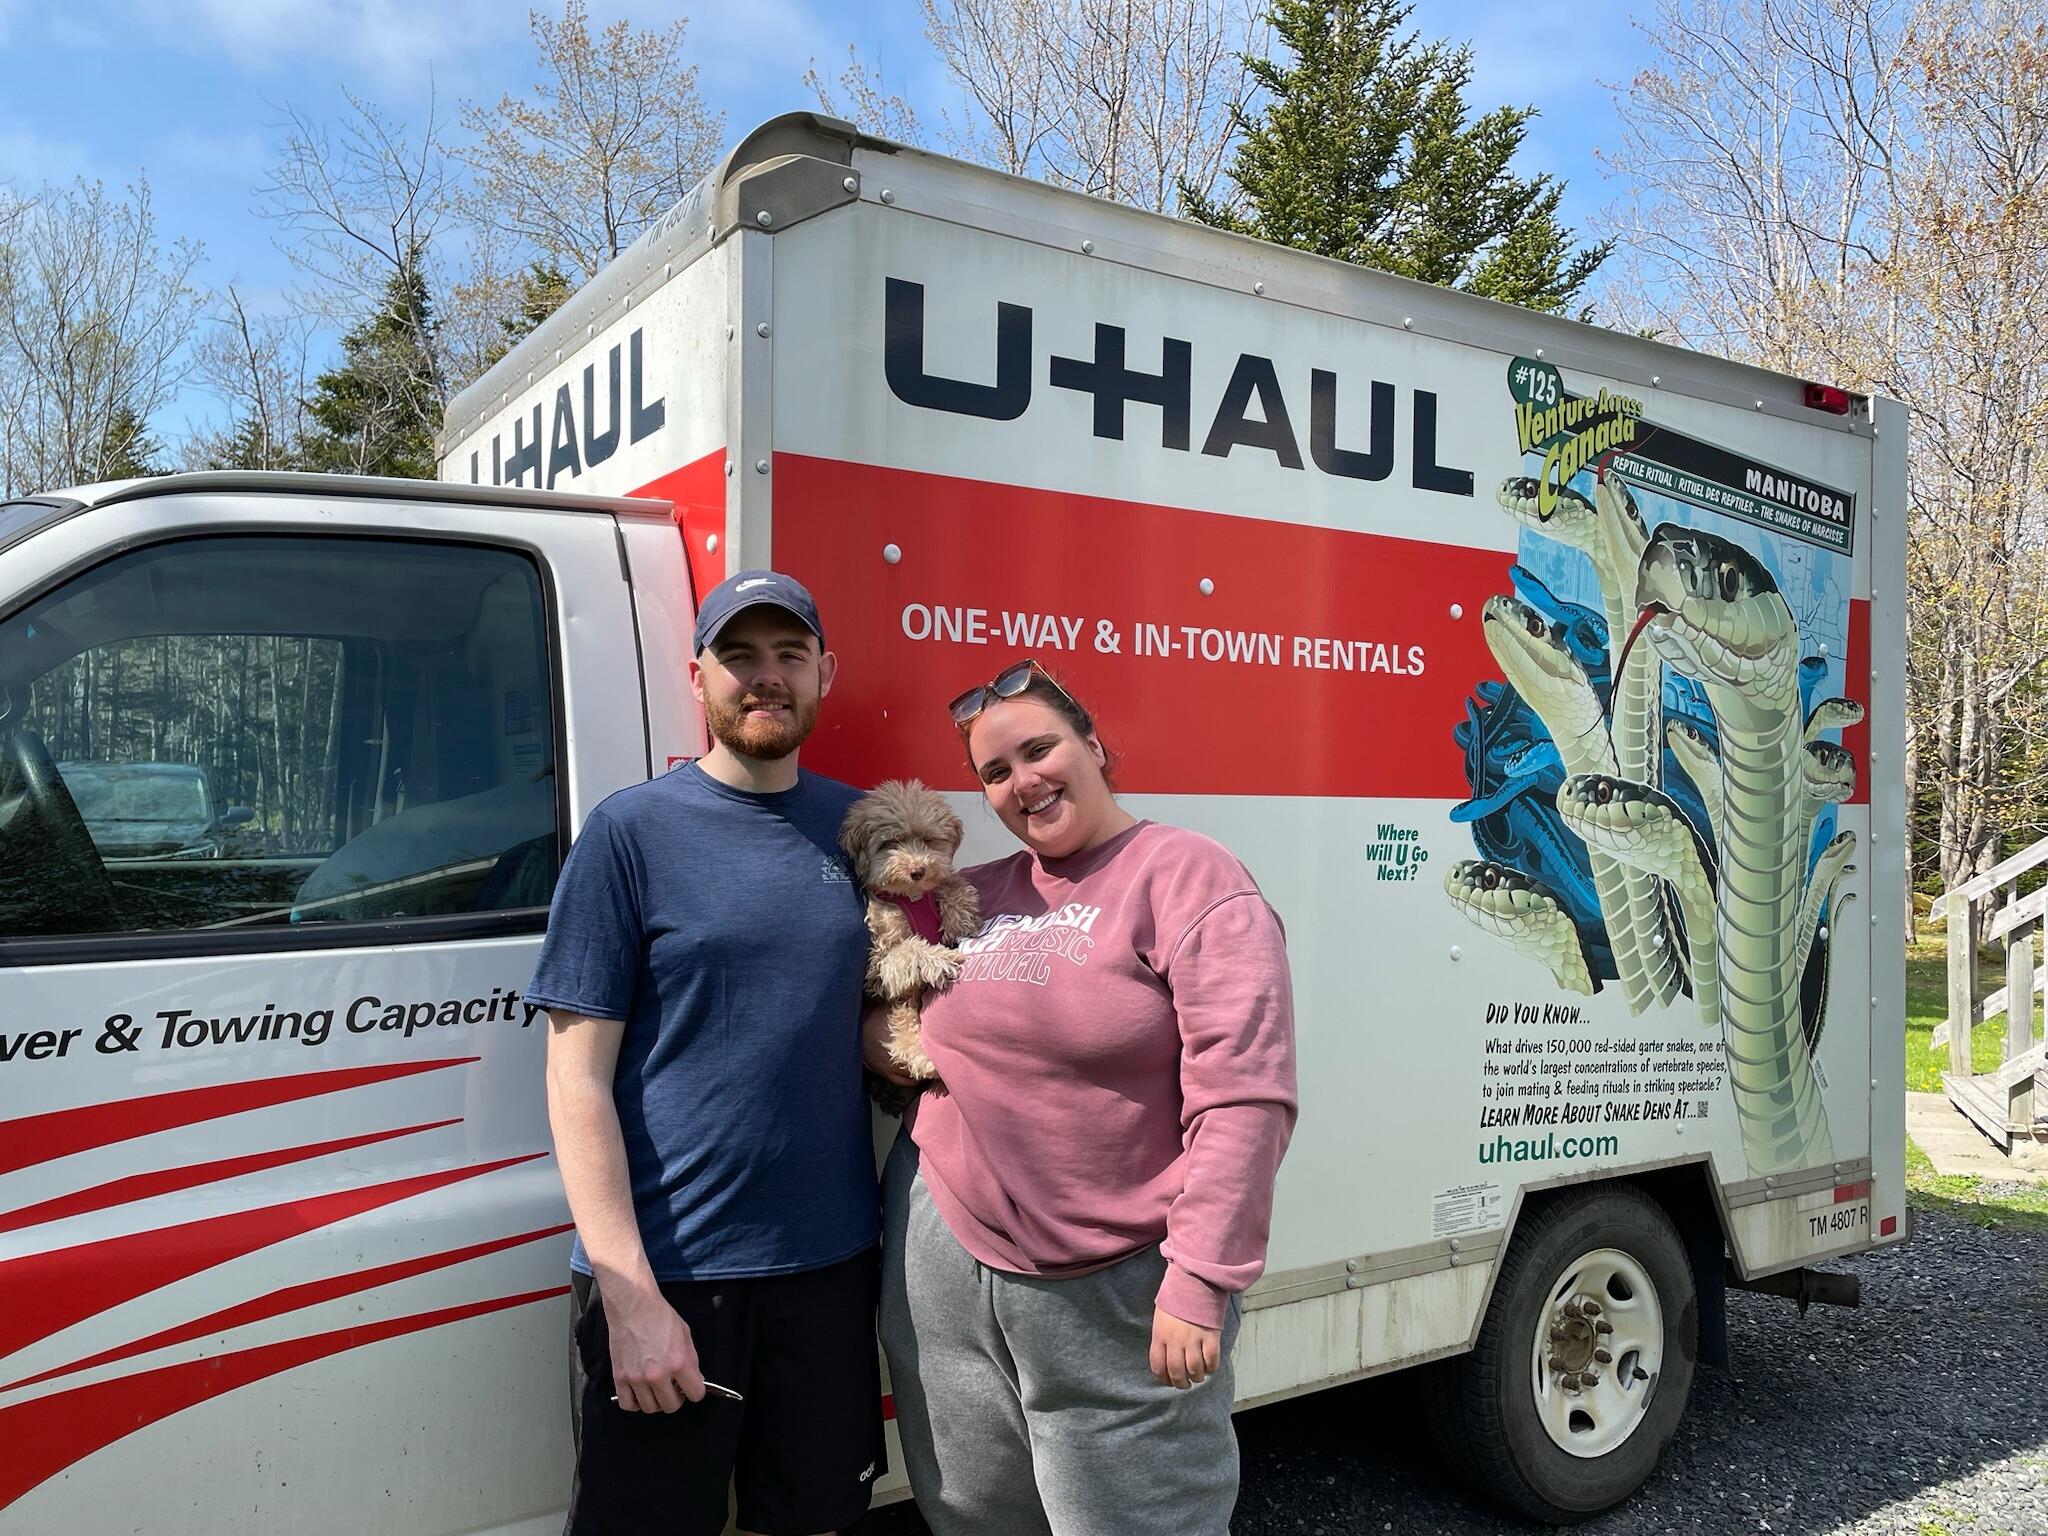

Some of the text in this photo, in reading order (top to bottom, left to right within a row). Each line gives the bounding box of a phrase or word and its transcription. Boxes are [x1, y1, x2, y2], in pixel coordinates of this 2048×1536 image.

[884, 276, 1475, 497] U-HAUL
[1515, 365, 1557, 405] #125
[1515, 387, 1644, 454] Venture Across
[1538, 413, 1636, 518] Canada
[1612, 455, 1645, 477] REPTILE
[1646, 466, 1672, 487] RITUAL
[1678, 477, 1704, 497] RITUEL
[1705, 486, 1720, 502] DES
[1721, 492, 1754, 514] REPTILES
[1760, 505, 1774, 520] THE
[1774, 510, 1801, 529] SNAKES
[1801, 520, 1811, 533] OF
[1811, 523, 1844, 543] NARCISSE
[1745, 468, 1845, 522] MANITOBA
[901, 603, 1085, 652] ONE-WAY
[1093, 618, 1122, 655] &
[1293, 637, 1426, 677] RENTALS
[1377, 823, 1419, 841] Where
[1366, 844, 1428, 866] Will U Go
[1377, 863, 1418, 881] Next?
[997, 927, 1095, 966] MUSIC
[95, 1012, 143, 1055] &
[155, 1003, 334, 1046] Towing
[346, 988, 540, 1038] Capacity
[1485, 1003, 1509, 1024] DID
[1514, 1002, 1540, 1024] YOU
[1485, 1038, 1725, 1055] What drives 150,000 red-sided garter snakes, one of
[1483, 1057, 1727, 1077] the world's largest concentrations of vertebrate species,
[1483, 1076, 1721, 1100] to join mating & feeding rituals in striking spectacle?
[1480, 1106, 1520, 1128] LEARN
[1522, 1103, 1559, 1125] MORE
[1560, 1102, 1602, 1124] ABOUT
[1604, 1101, 1640, 1122] SNAKE
[1642, 1100, 1671, 1120] DENS
[1479, 1132, 1618, 1164] uhaul.com
[1809, 1205, 1868, 1238] TM 4807 R
